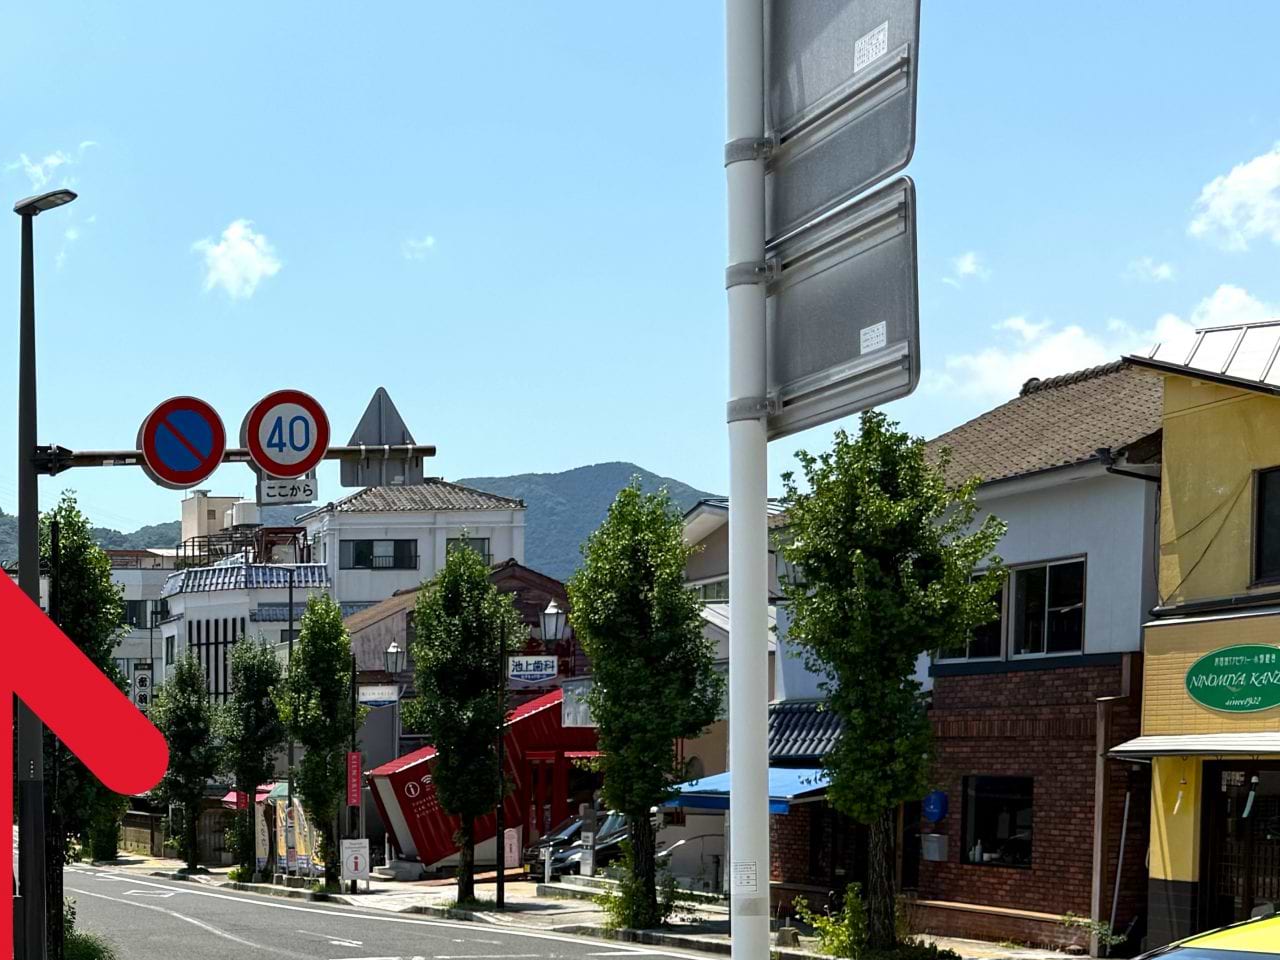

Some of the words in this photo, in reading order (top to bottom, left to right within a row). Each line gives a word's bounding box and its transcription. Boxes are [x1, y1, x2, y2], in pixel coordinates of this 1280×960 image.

[266, 416, 309, 452] 40
[266, 484, 313, 497] ここから
